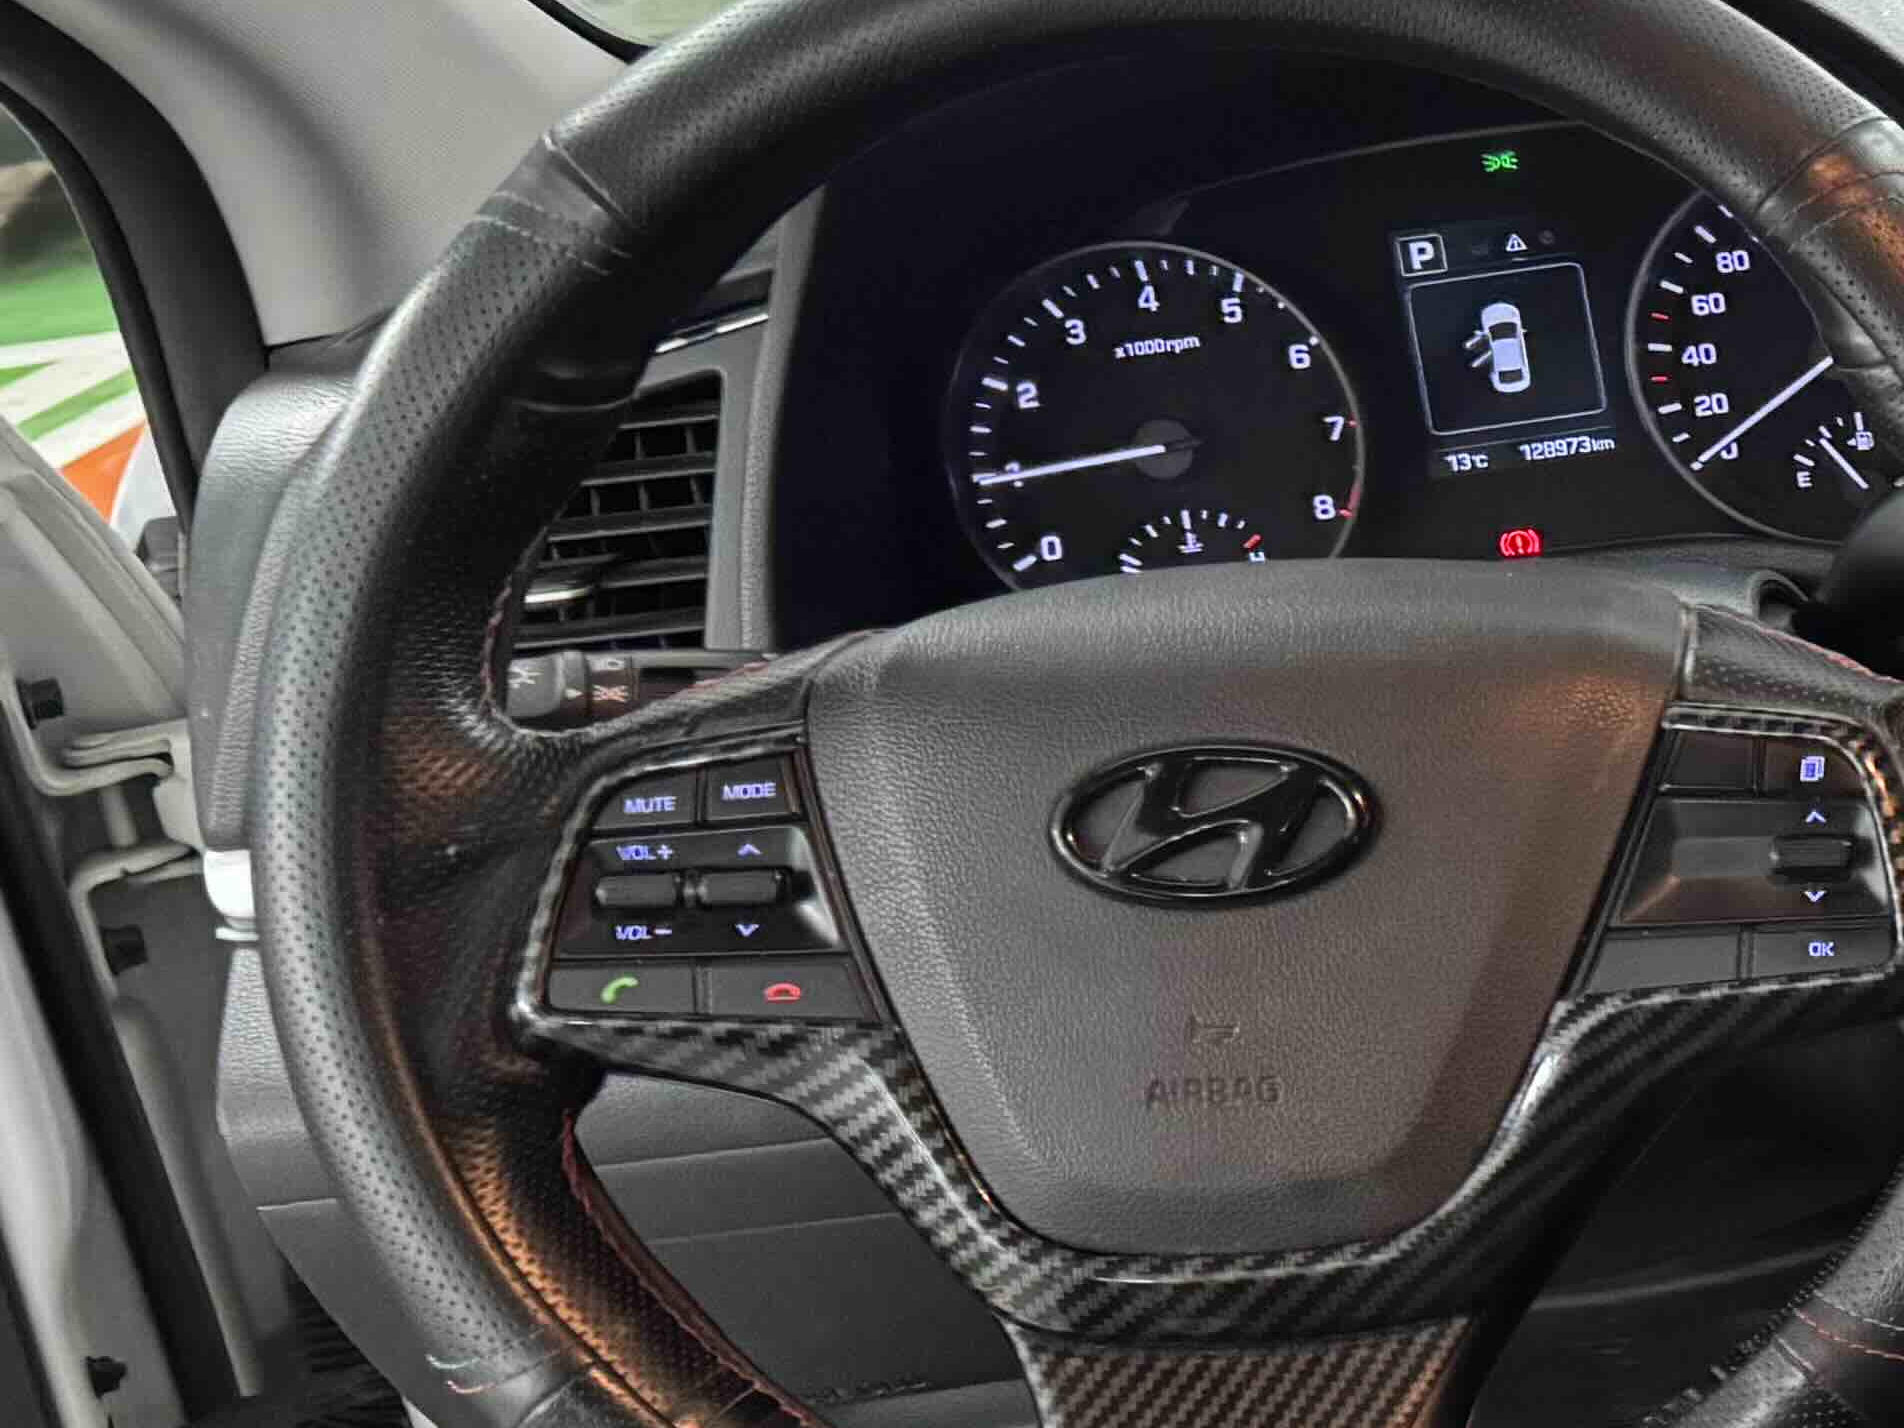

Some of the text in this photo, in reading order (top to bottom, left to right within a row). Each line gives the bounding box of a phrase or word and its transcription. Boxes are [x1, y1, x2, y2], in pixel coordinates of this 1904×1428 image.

[1409, 241, 1434, 269] P
[1716, 250, 1751, 273] 80
[1138, 284, 1162, 313] 4
[1221, 297, 1244, 325] 5
[1691, 292, 1727, 317] 60
[1064, 318, 1087, 347] 3
[1287, 346, 1312, 371] 6
[1681, 342, 1718, 367] 40
[1016, 382, 1042, 410] 2
[1694, 393, 1730, 418] 20
[1323, 415, 1346, 442] 7
[1797, 470, 1815, 489] E
[1312, 494, 1338, 521] 8
[1039, 536, 1064, 562] 0
[623, 782, 778, 815] MUTE MODE
[1808, 941, 1836, 958] OK
[1145, 1074, 1284, 1111] AIRBAG
